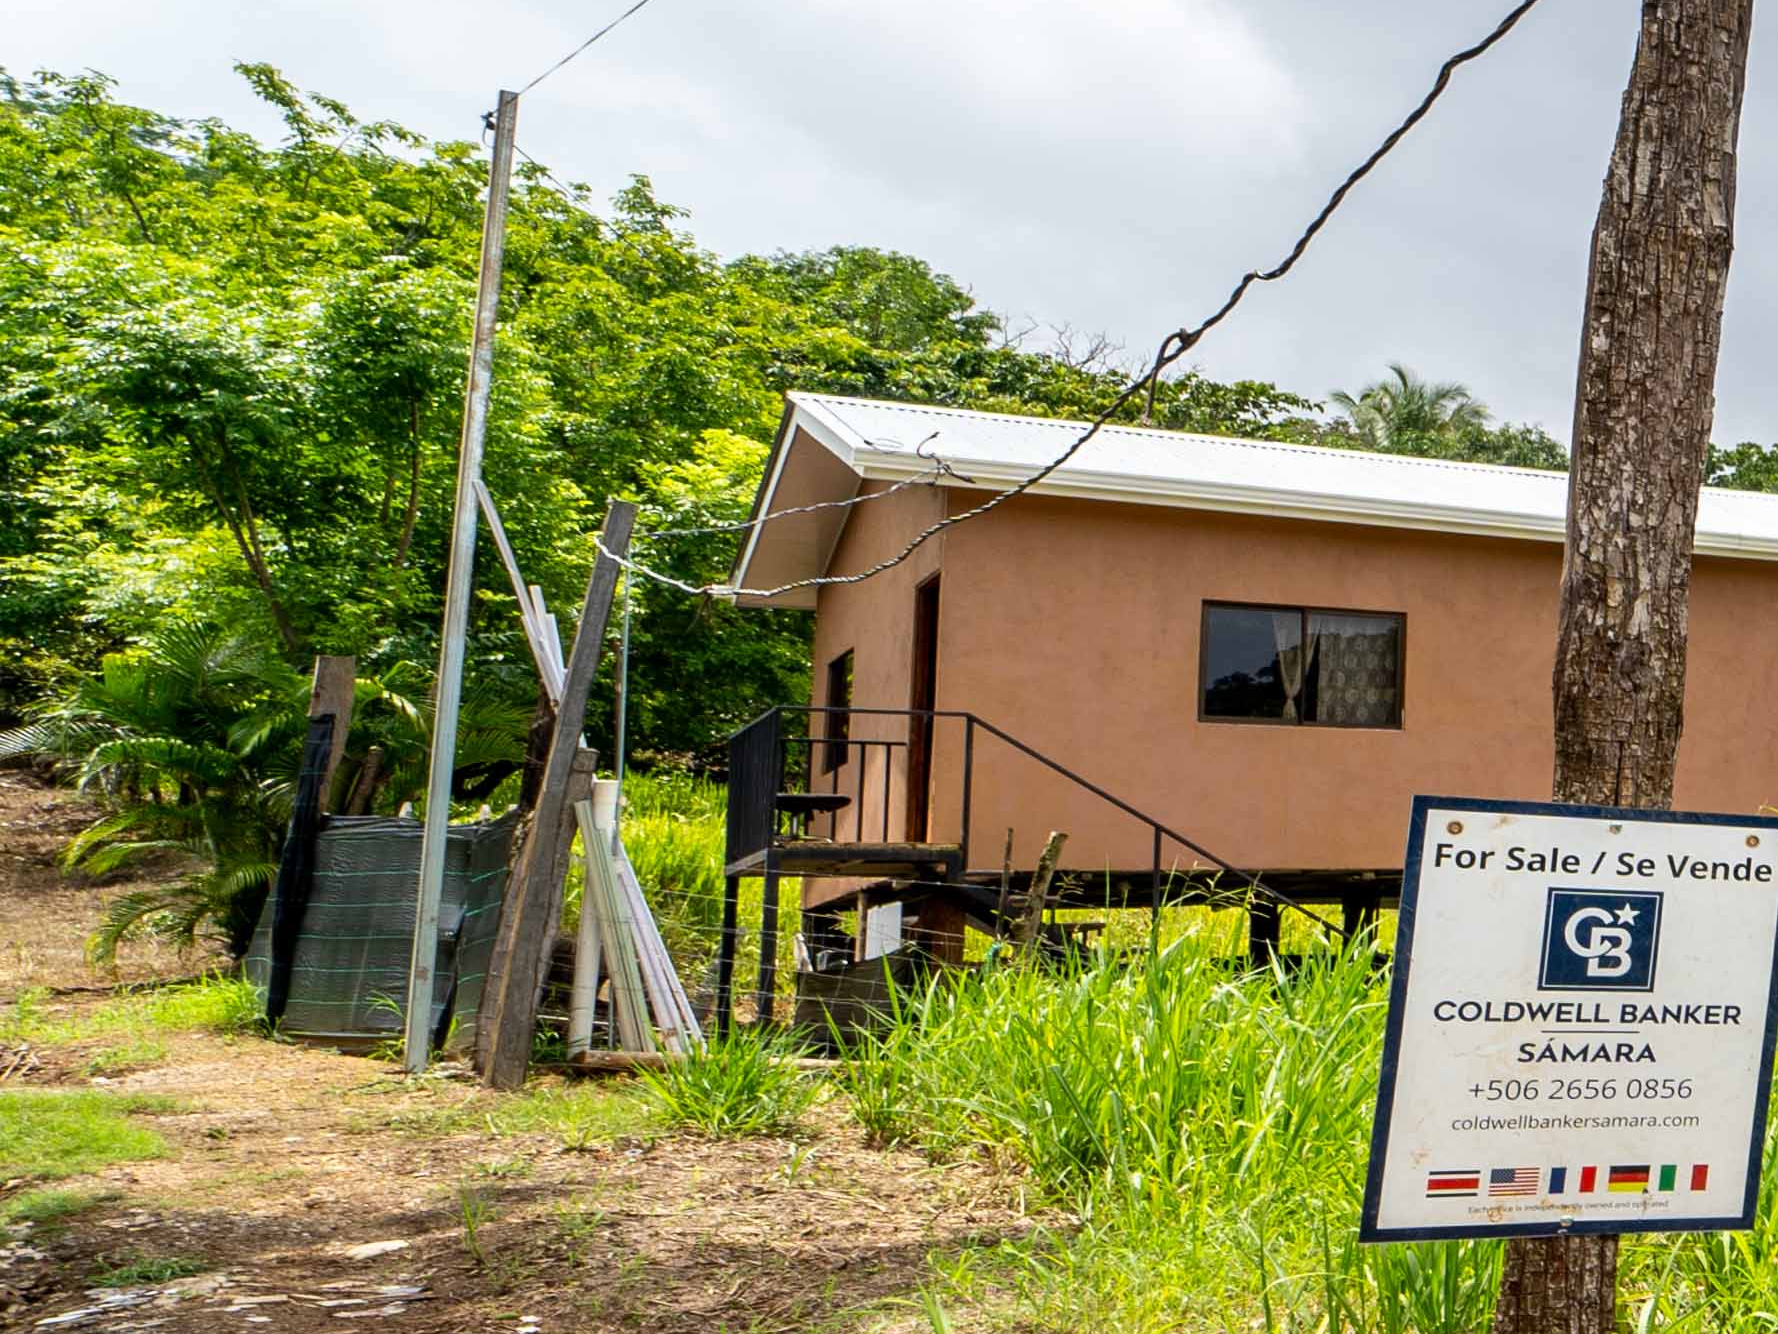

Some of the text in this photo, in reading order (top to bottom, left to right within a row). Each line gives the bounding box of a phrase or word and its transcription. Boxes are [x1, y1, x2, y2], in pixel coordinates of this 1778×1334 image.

[1435, 843, 1773, 882] For Sale / Se Vende
[1564, 907, 1633, 977] CB
[1433, 1000, 1742, 1025] COLDWELL BANKER
[1517, 1038, 1657, 1063] SÁMARA
[1469, 1078, 1693, 1101] +506 2656 0856
[1452, 1114, 1700, 1131] coldwellbankersamara.com
